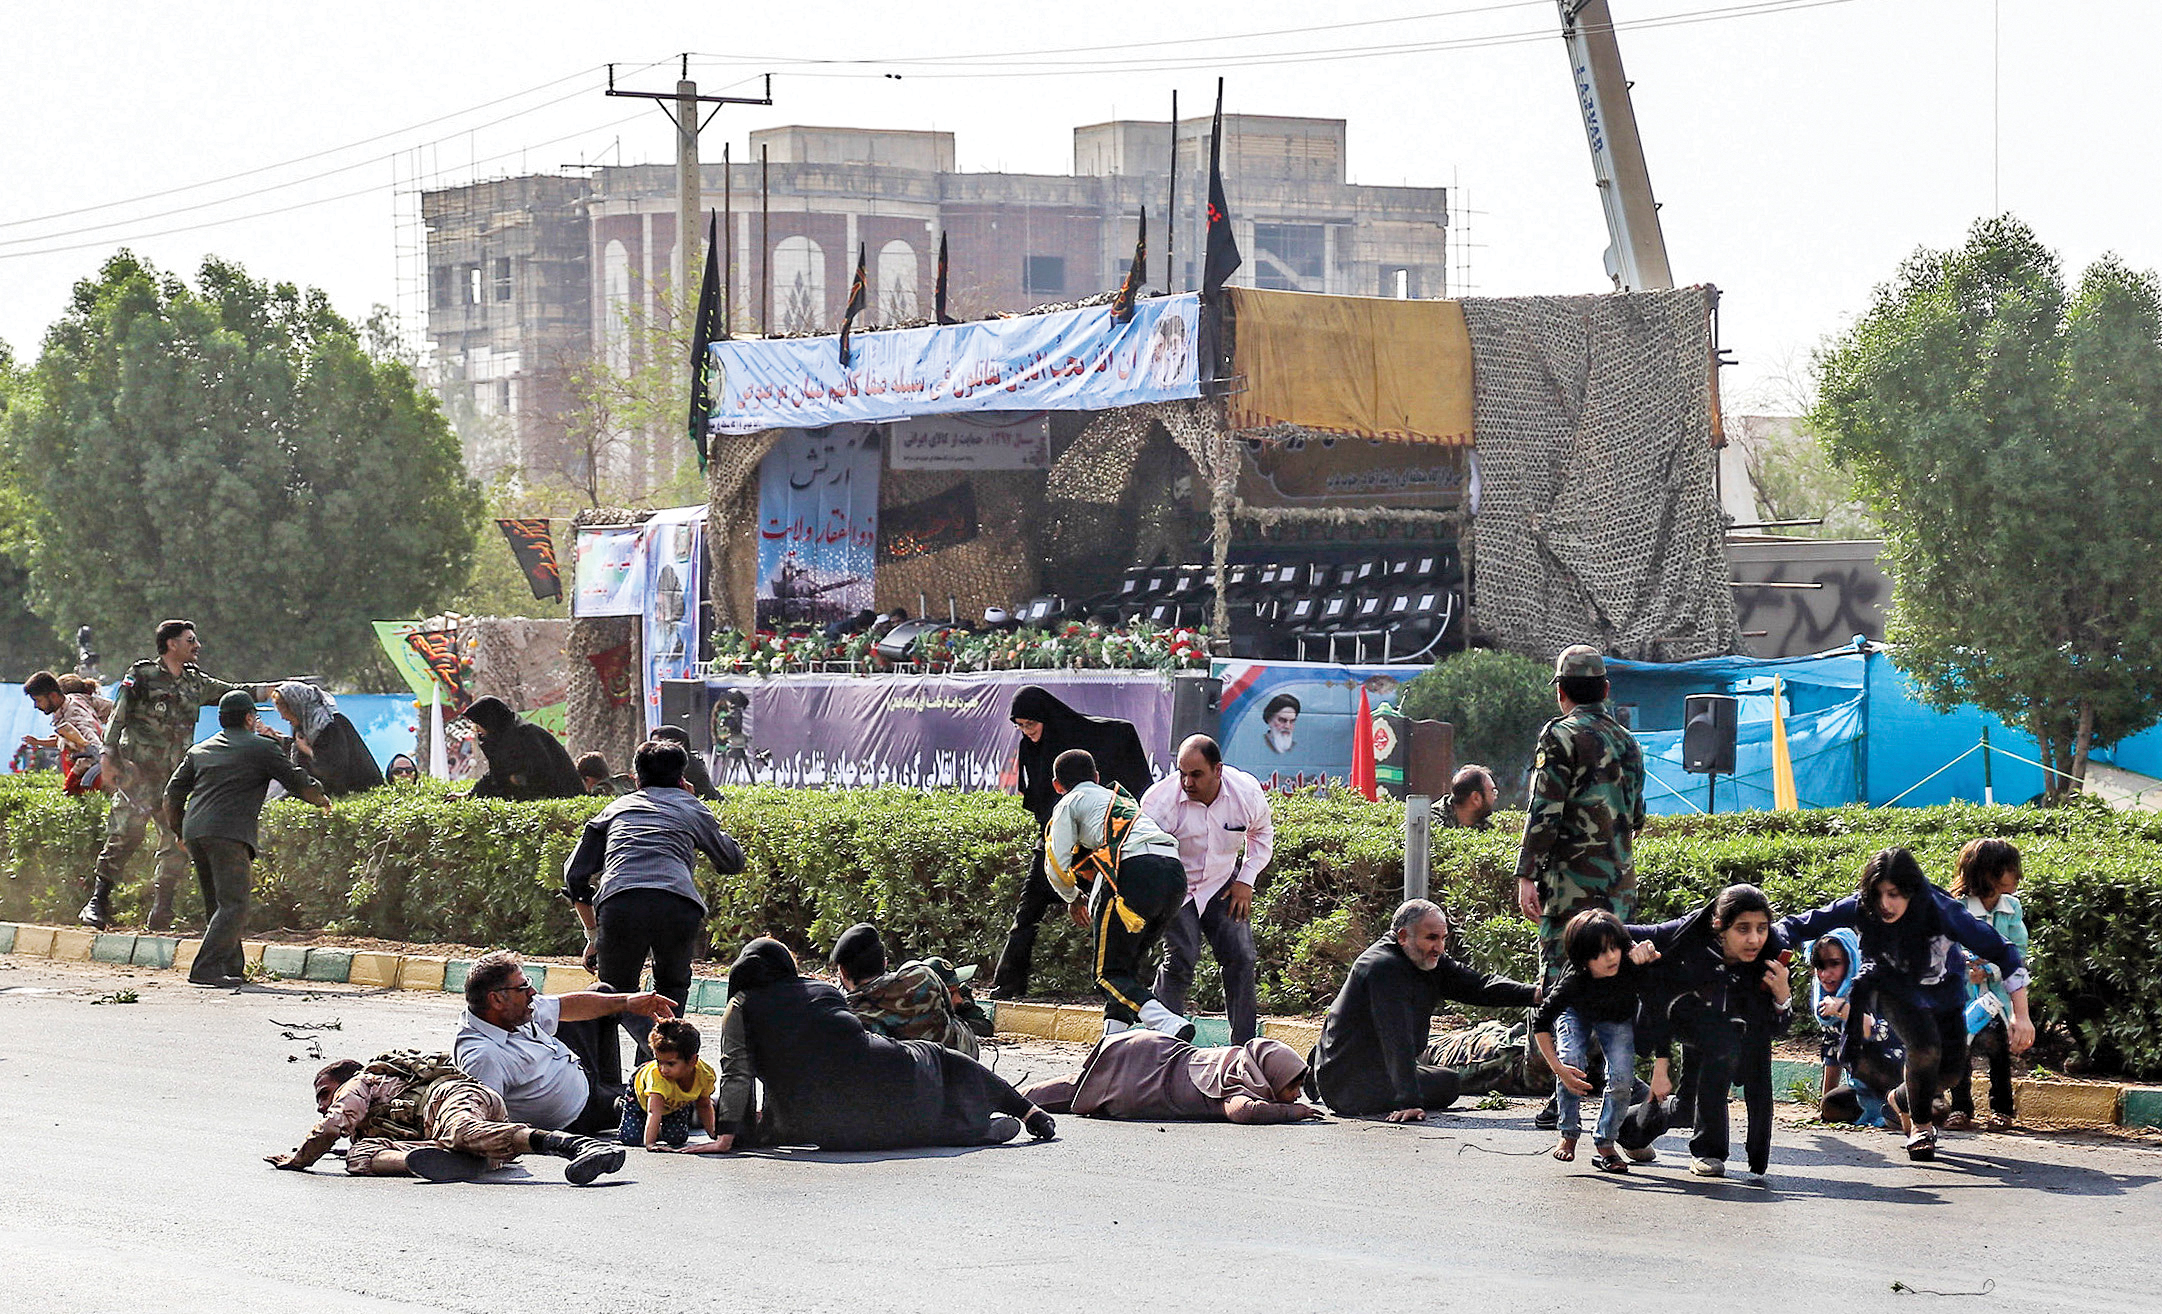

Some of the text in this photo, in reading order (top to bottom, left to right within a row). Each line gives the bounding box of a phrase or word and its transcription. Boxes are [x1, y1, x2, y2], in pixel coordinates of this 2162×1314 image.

[1576, 65, 1603, 154] LAJVAR
[789, 445, 850, 490] ارتش
[761, 515, 813, 557] ولایت
[816, 508, 875, 547] ذوالفقار
[802, 750, 826, 785] غفلت
